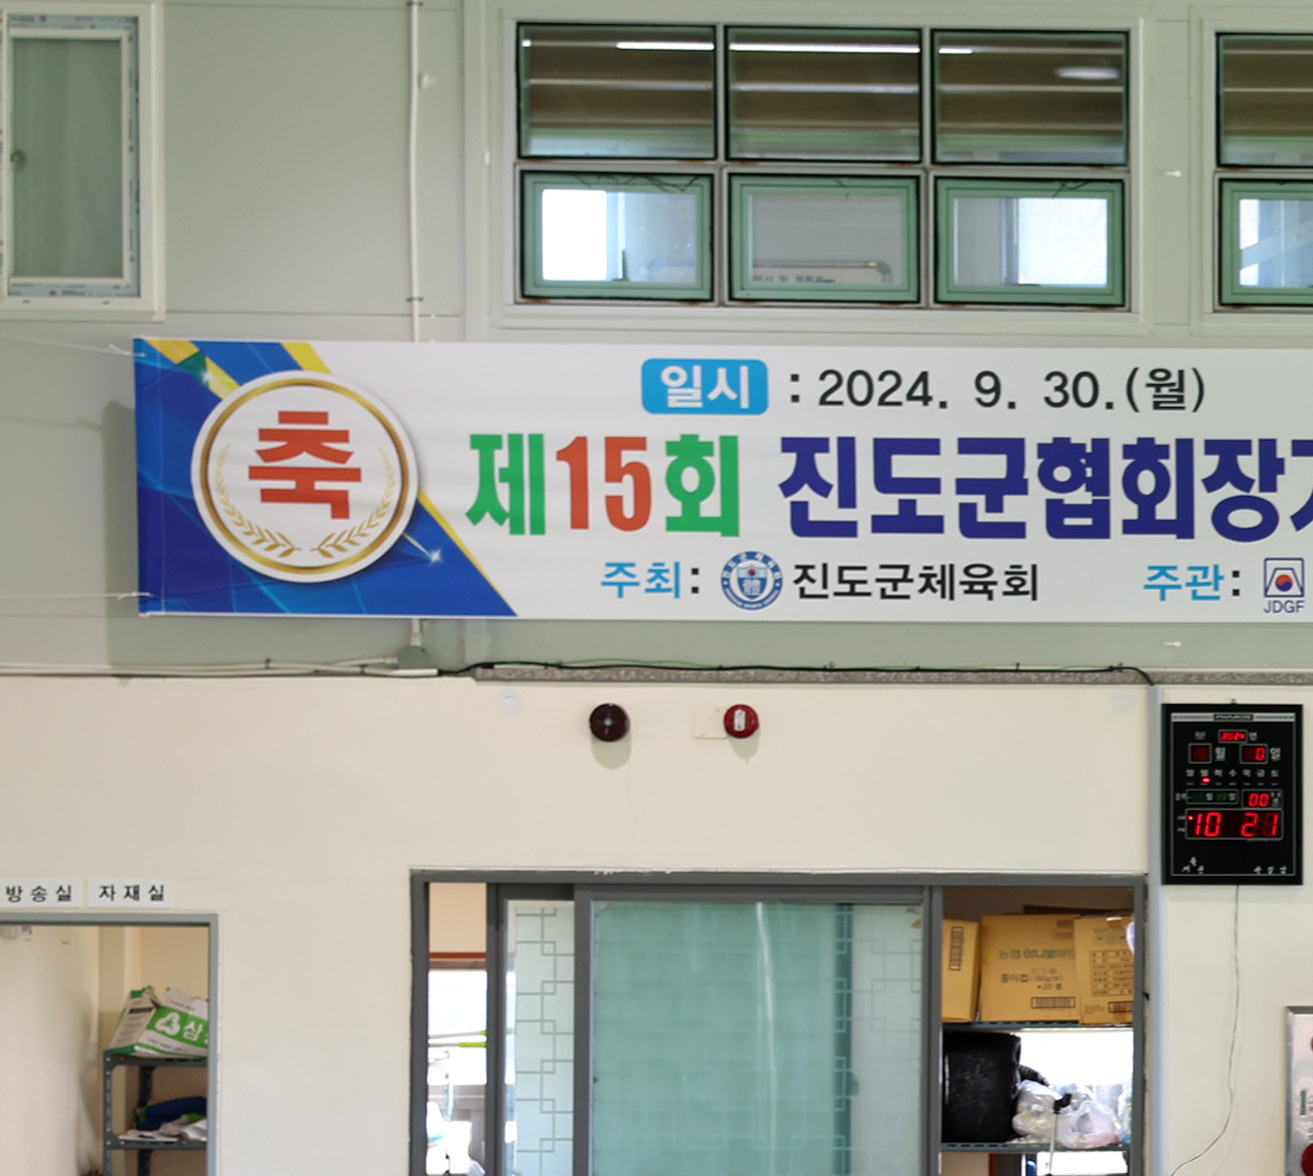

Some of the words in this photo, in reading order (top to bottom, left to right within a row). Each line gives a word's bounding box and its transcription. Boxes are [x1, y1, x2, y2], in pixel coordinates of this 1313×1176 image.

[661, 366, 750, 409] 일시
[818, 369, 948, 410] 2024.
[973, 370, 1017, 410] 9.
[1043, 367, 1205, 414] 30.(월)
[248, 410, 362, 521] 축
[465, 433, 740, 537] 제15회
[601, 561, 700, 600] 주최:
[792, 562, 1039, 602] 진도군체육회
[1143, 564, 1241, 602] 주관:
[1263, 600, 1305, 614] JDGF
[5, 884, 73, 903] 방송실
[98, 883, 166, 902] 자재실
